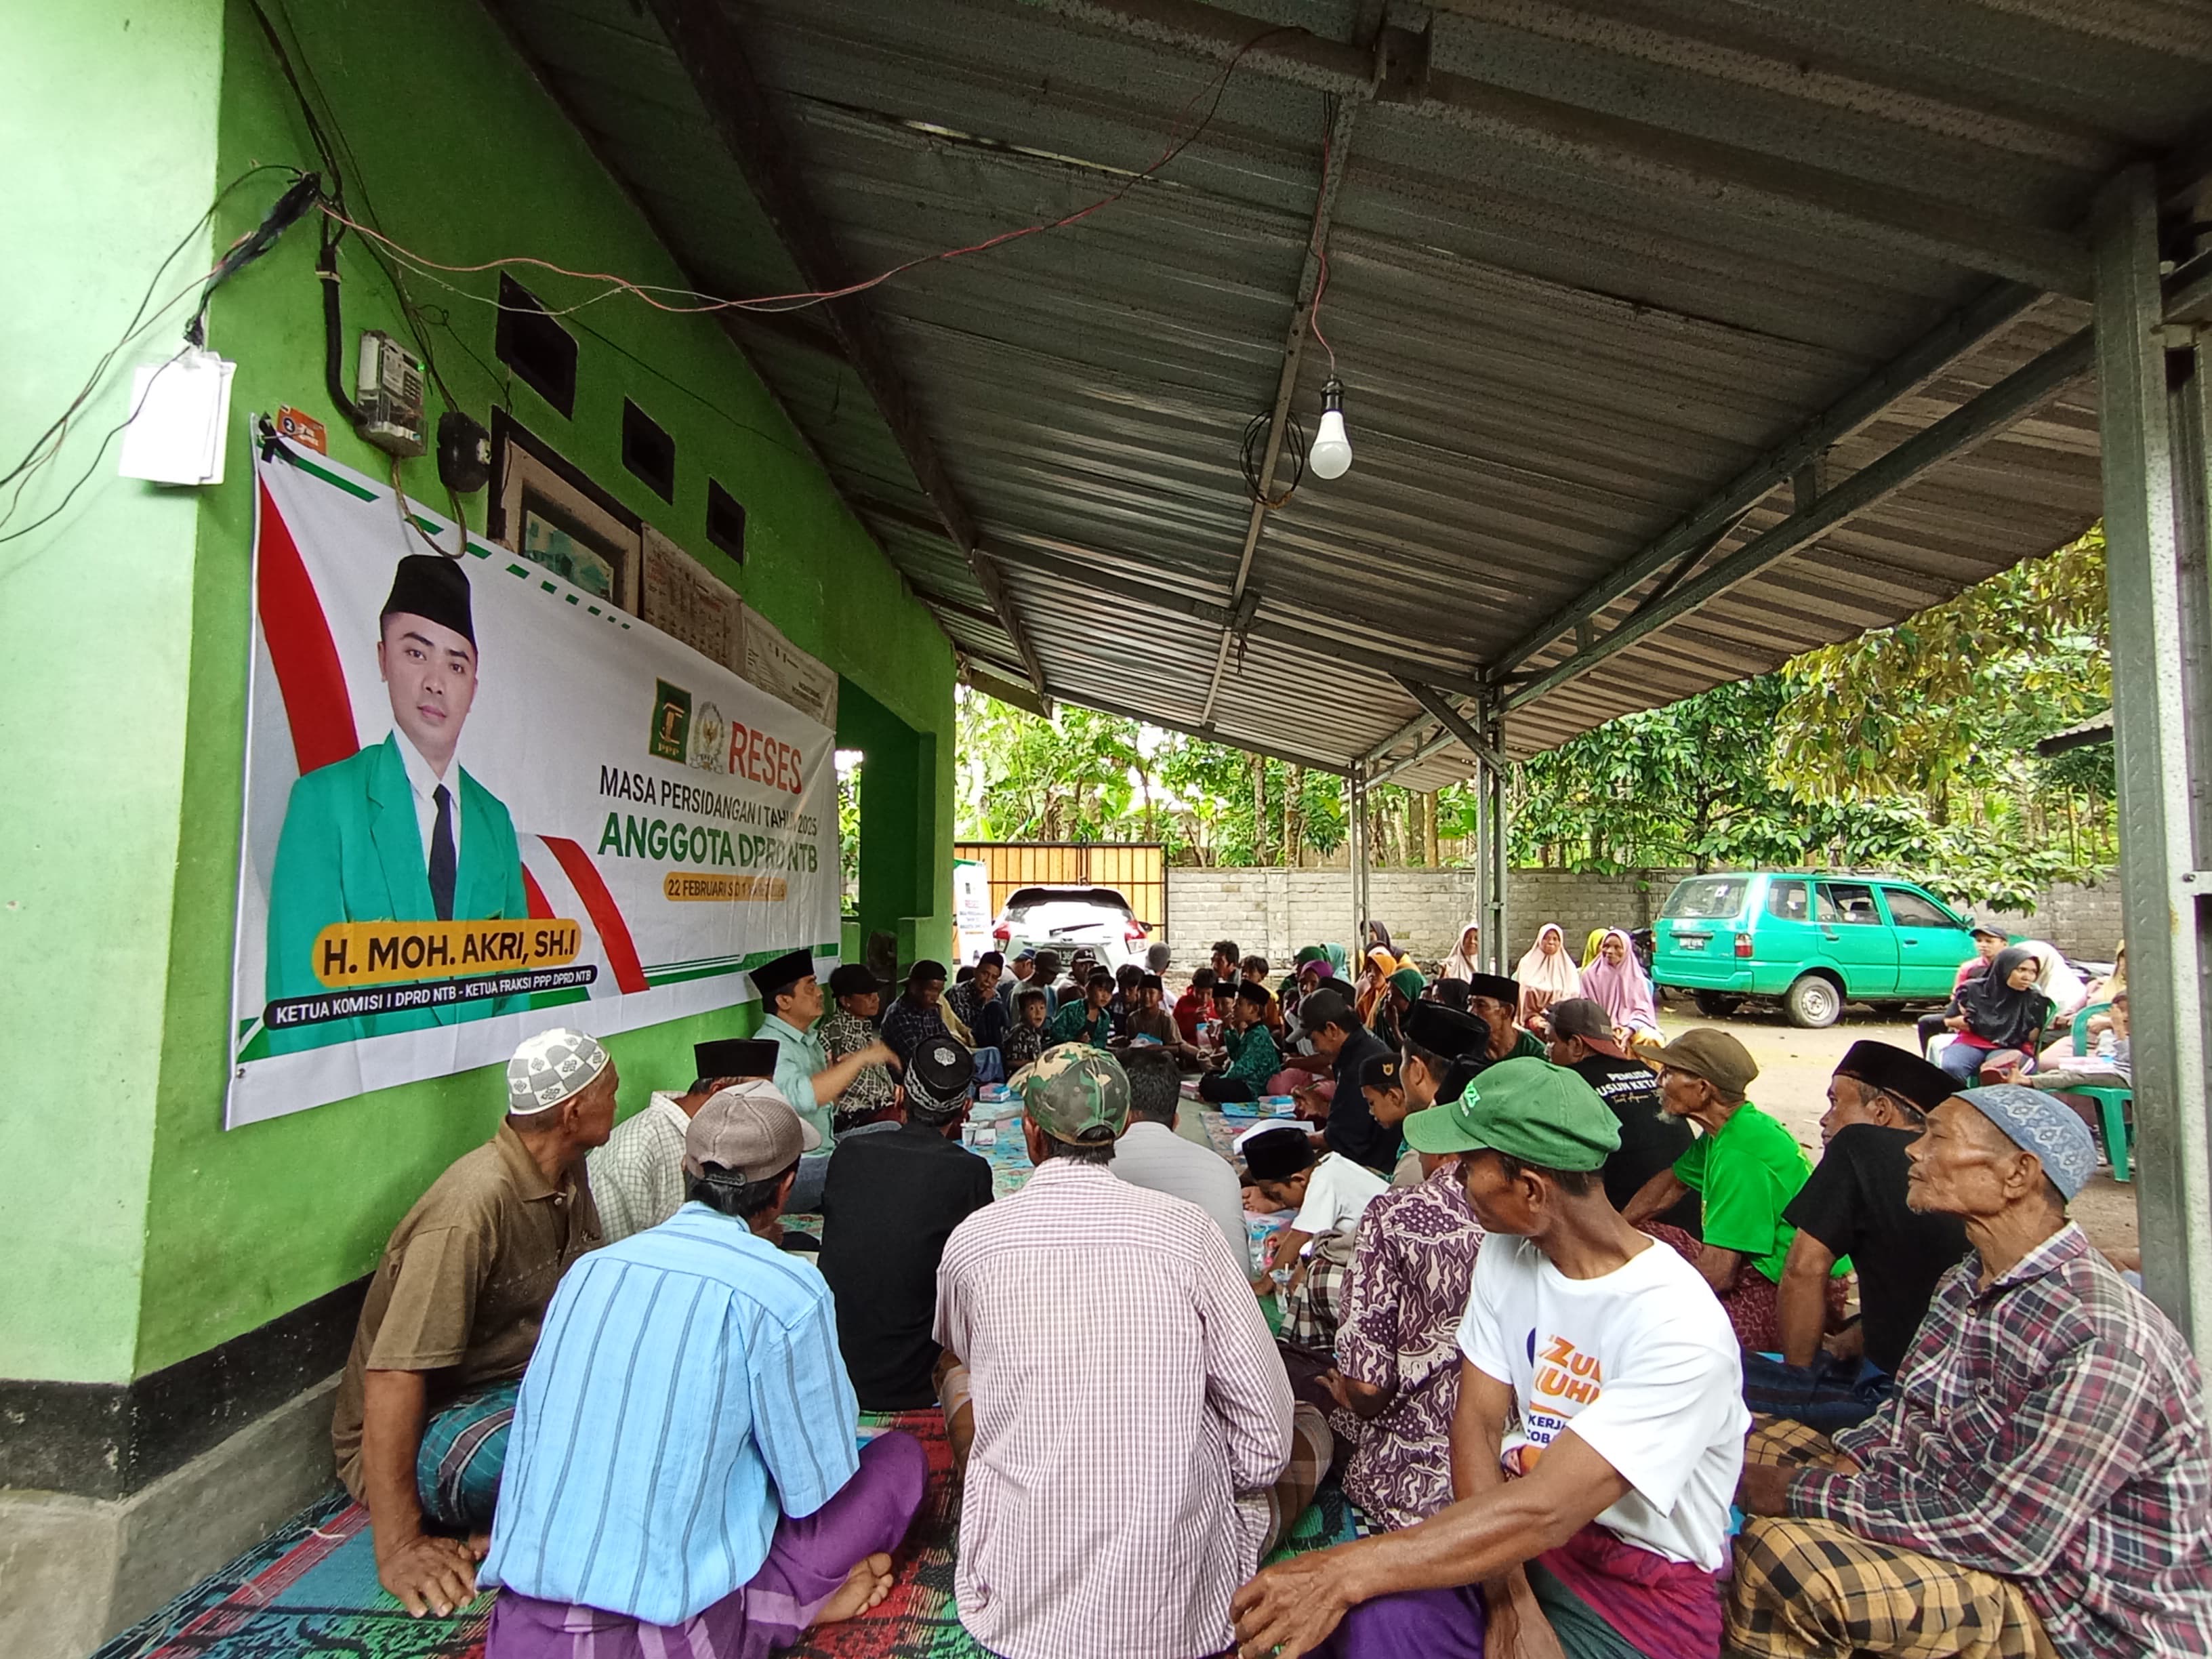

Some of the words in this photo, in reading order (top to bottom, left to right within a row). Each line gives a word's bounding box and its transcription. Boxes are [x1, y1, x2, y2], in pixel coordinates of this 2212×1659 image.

[729, 721, 802, 795] RESES
[600, 764, 656, 805] MASA
[661, 779, 756, 824] PERSIDANGAN
[758, 804, 762, 825] I
[797, 814, 817, 836] 2025
[597, 812, 736, 866] ANGGOTA
[738, 833, 785, 868] DPRD
[787, 842, 818, 873] NTB
[668, 879, 681, 897] 22
[682, 880, 726, 897] FEBRUARI
[323, 939, 358, 976] H.
[367, 935, 455, 972] MOH.
[462, 931, 529, 965] AKRI,
[534, 929, 576, 957] SH.I
[276, 1002, 330, 1024] KETUA
[332, 994, 383, 1015] KOMISI
[386, 993, 392, 1008] I
[394, 989, 431, 1007] DPRD
[432, 986, 456, 1002] NTB
[465, 981, 498, 998] KETUA
[499, 977, 531, 993] FRAKSI
[533, 976, 552, 989] PPP
[552, 973, 575, 986] DPRD
[575, 970, 592, 983] NTB
